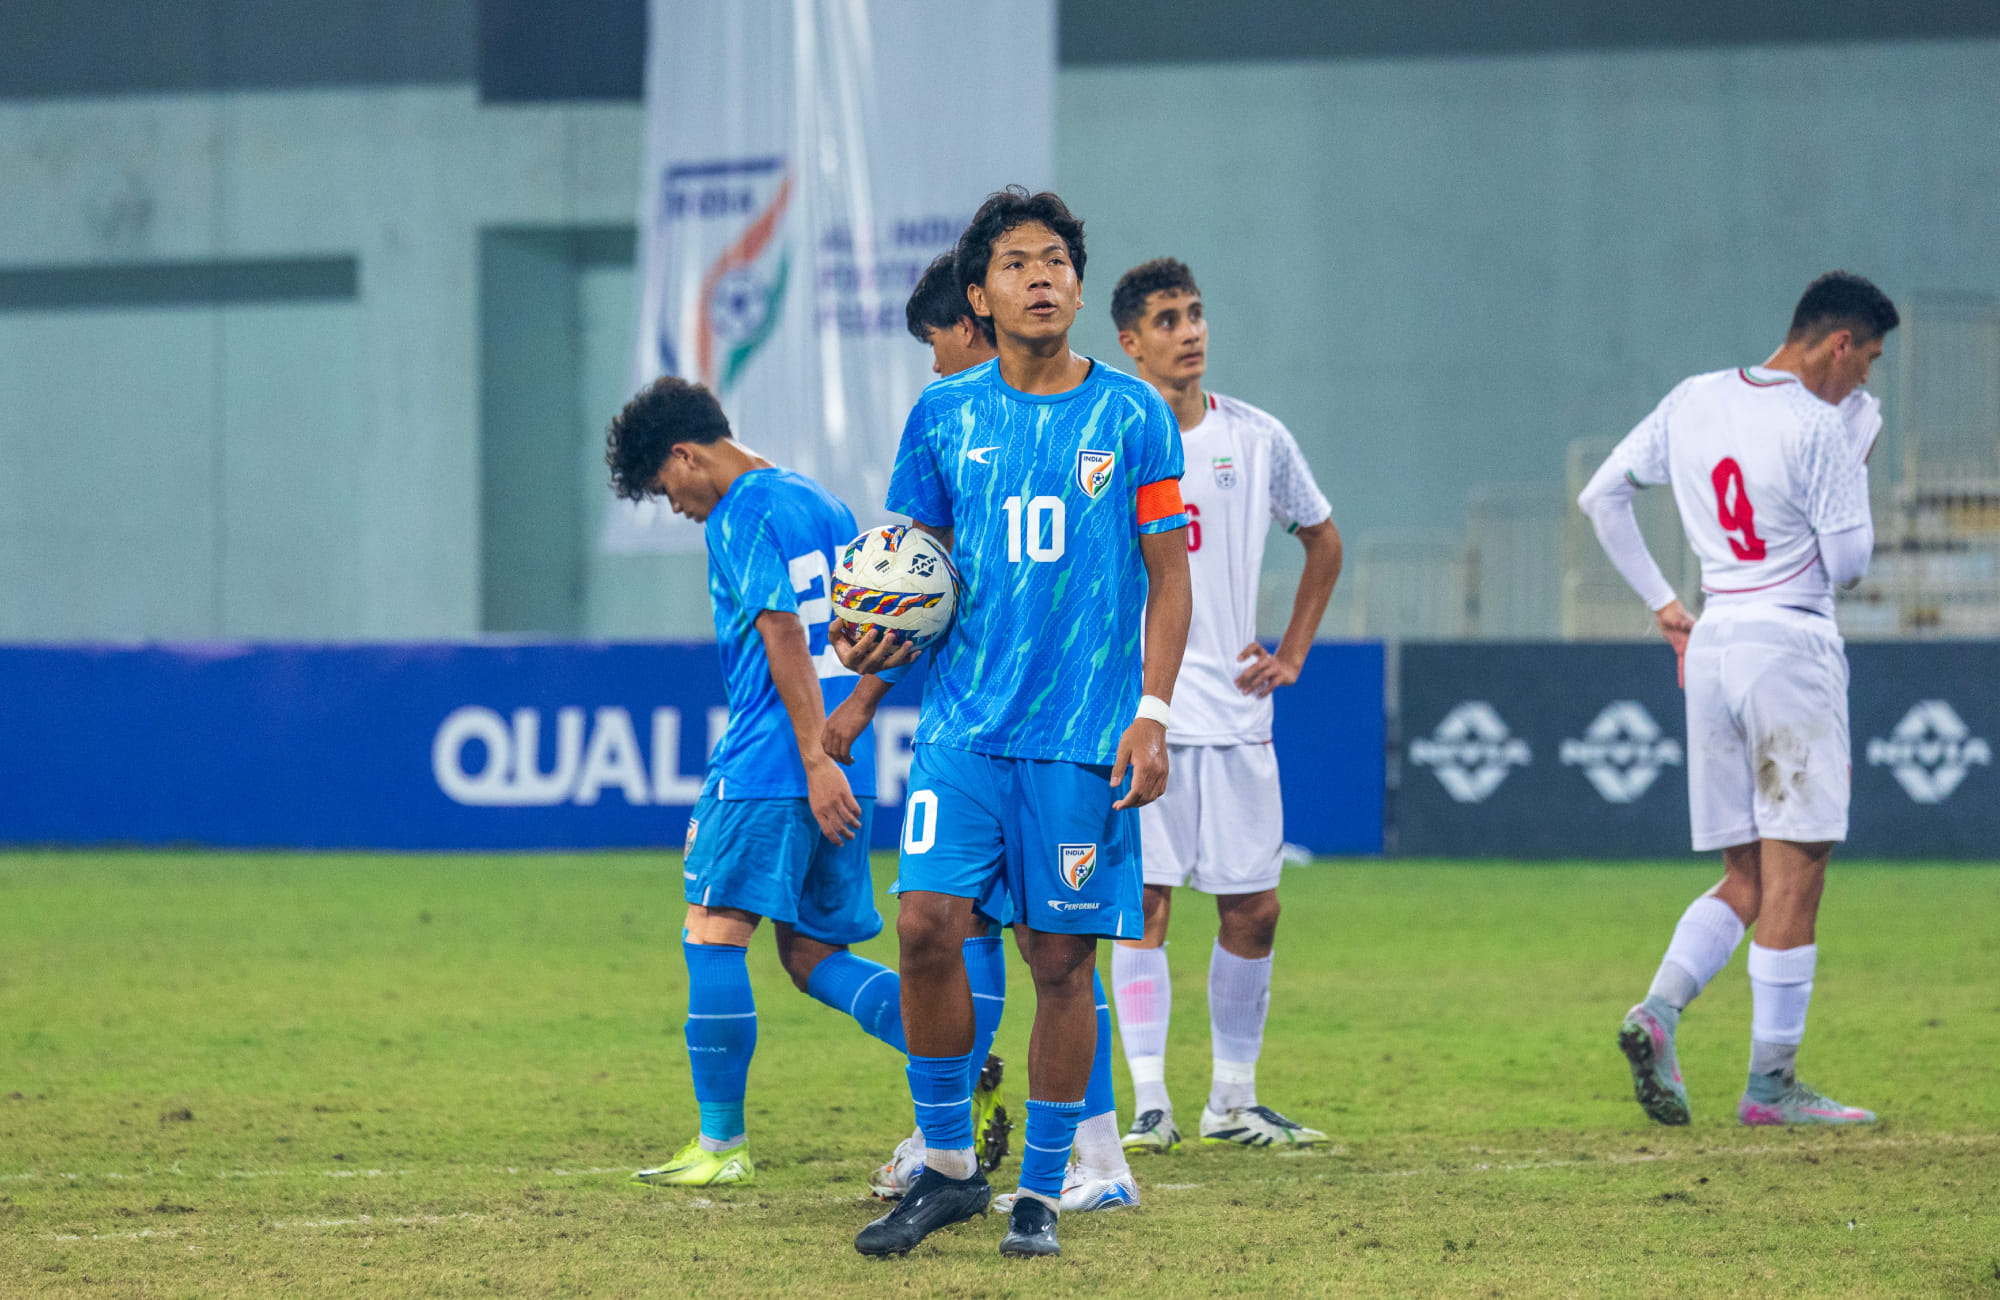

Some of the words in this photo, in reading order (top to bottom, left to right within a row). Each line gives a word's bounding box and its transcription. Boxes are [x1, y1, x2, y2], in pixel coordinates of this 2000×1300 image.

[1083, 455, 1103, 463] INDIA
[1711, 457, 1767, 561] 9
[1001, 496, 1066, 562] 10
[1064, 902, 1100, 911] PERFORMAX
